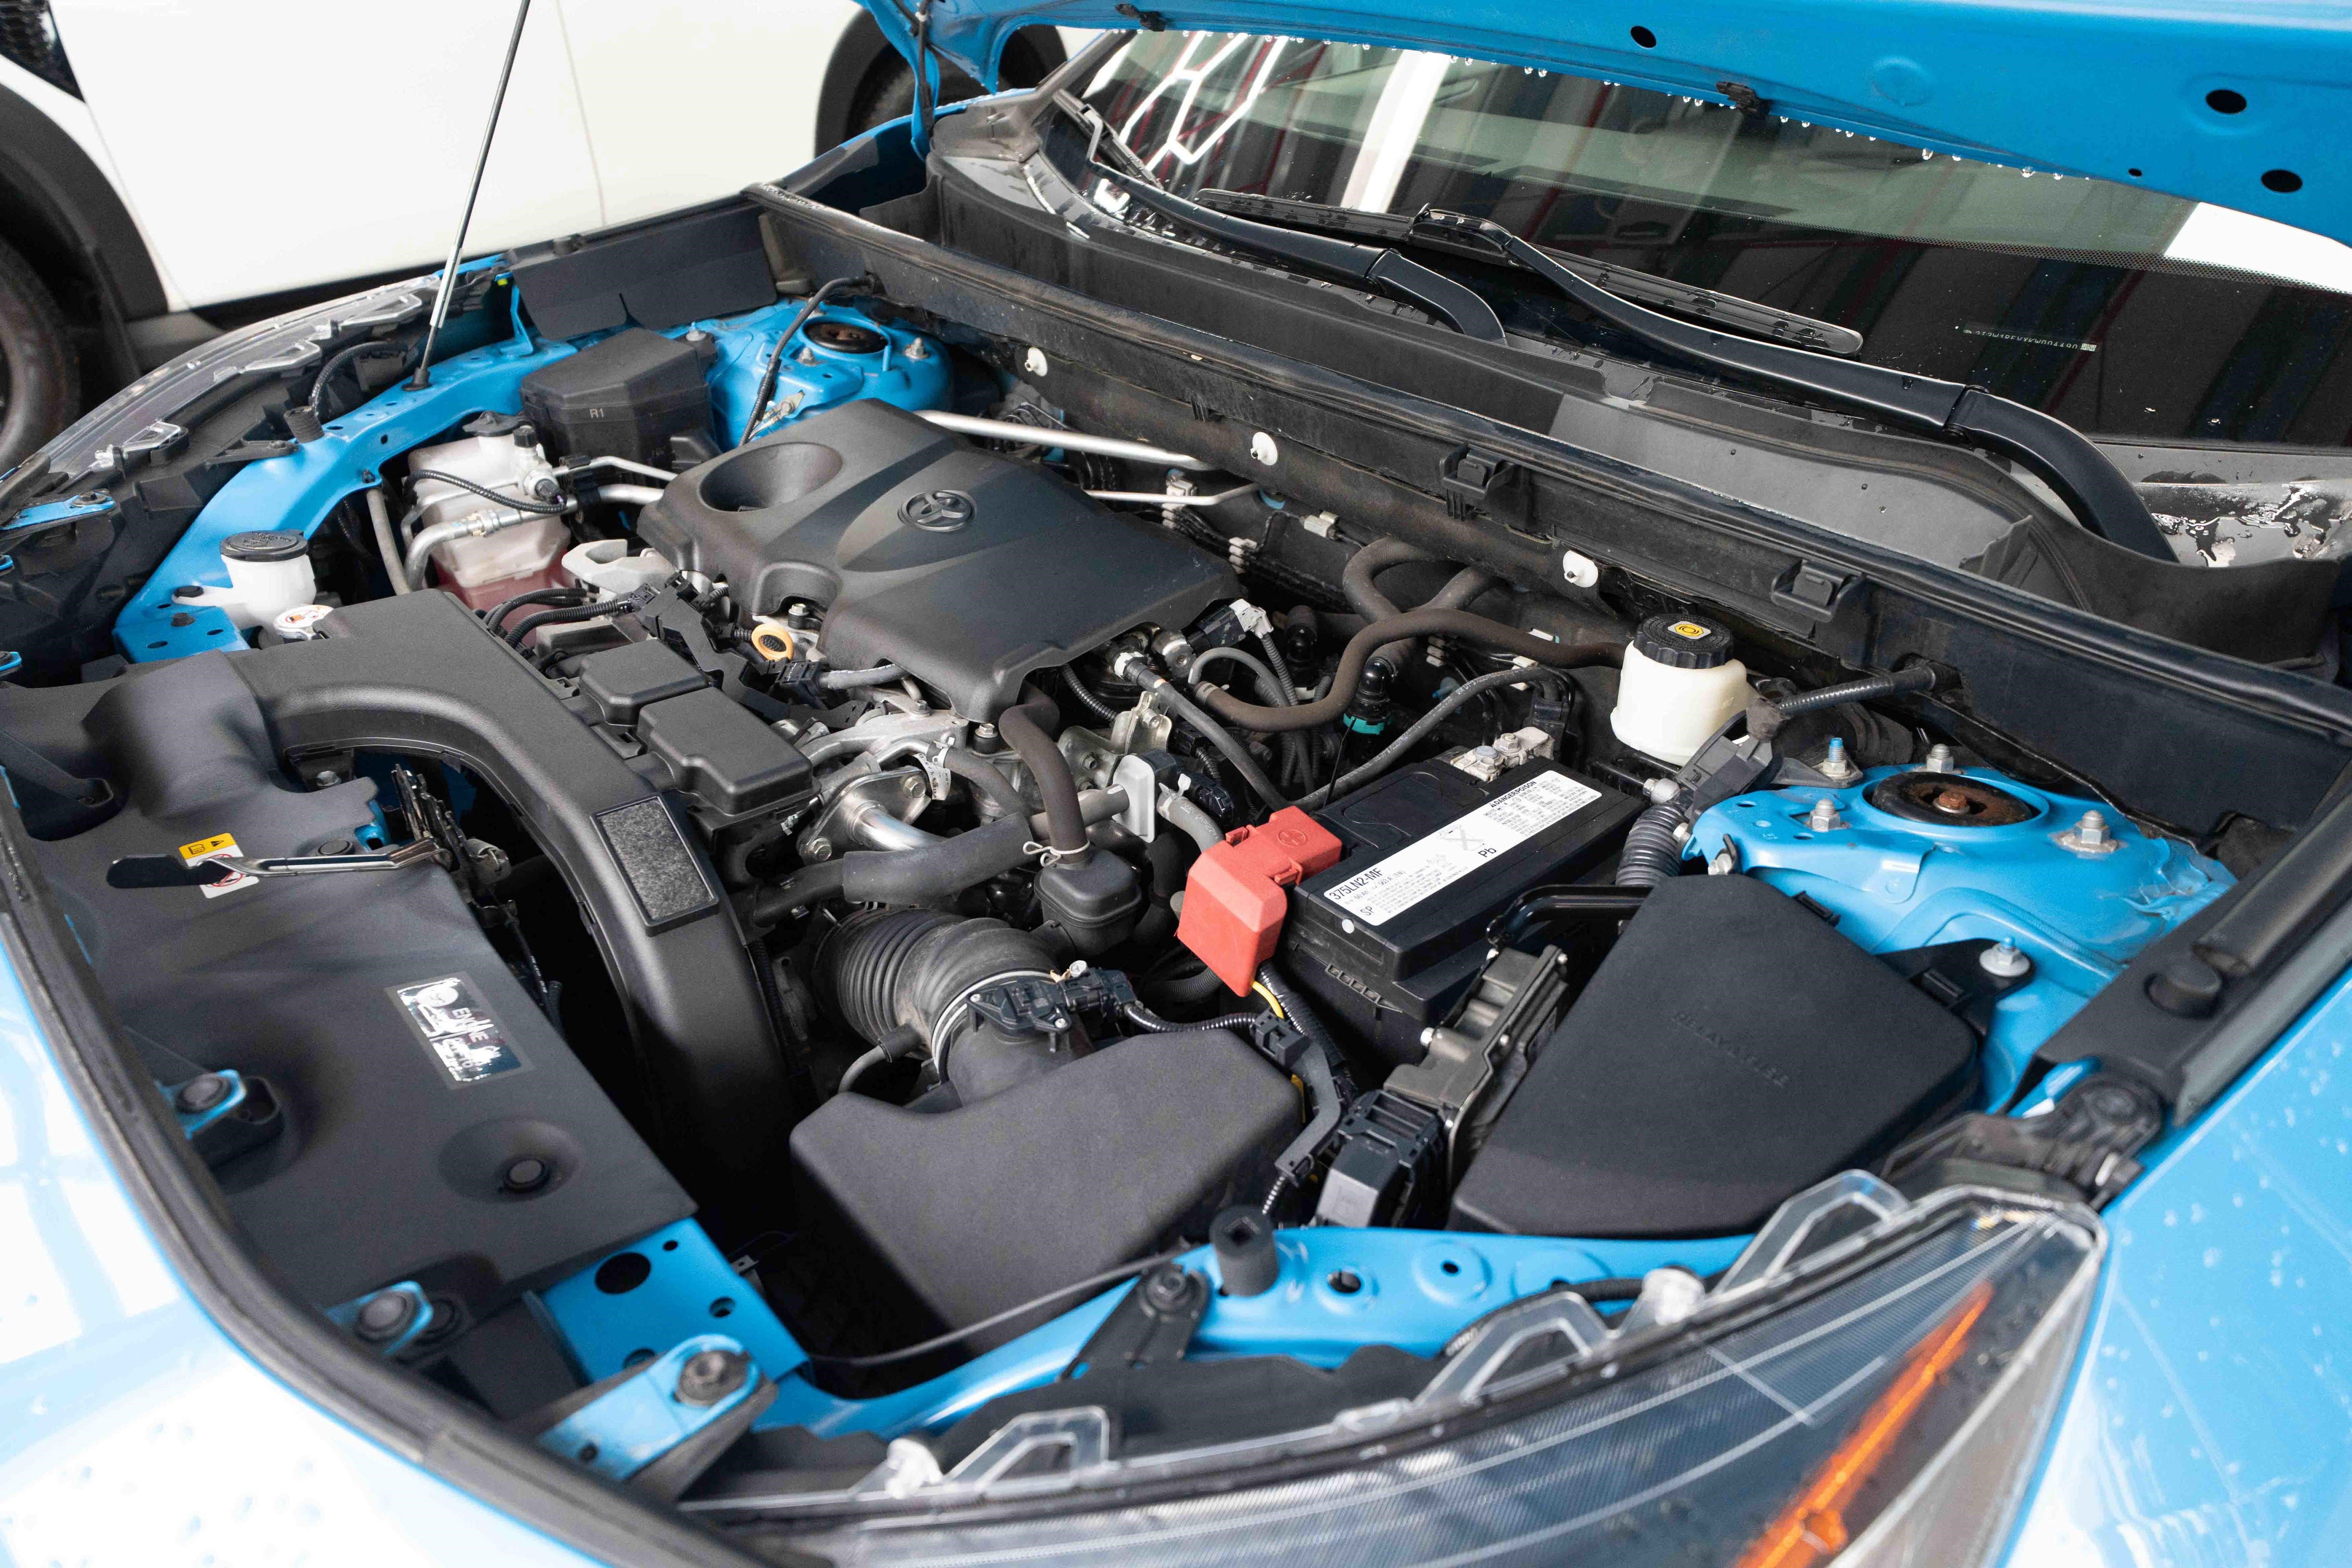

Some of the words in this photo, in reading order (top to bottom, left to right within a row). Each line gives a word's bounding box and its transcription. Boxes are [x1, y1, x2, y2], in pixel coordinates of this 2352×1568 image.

[590, 408, 604, 418] R1
[1494, 781, 1537, 804] DANGER/POISON
[1478, 848, 1497, 858] Pb
[1329, 868, 1383, 900] 375LN2-MF
[1360, 906, 1374, 915] SP
